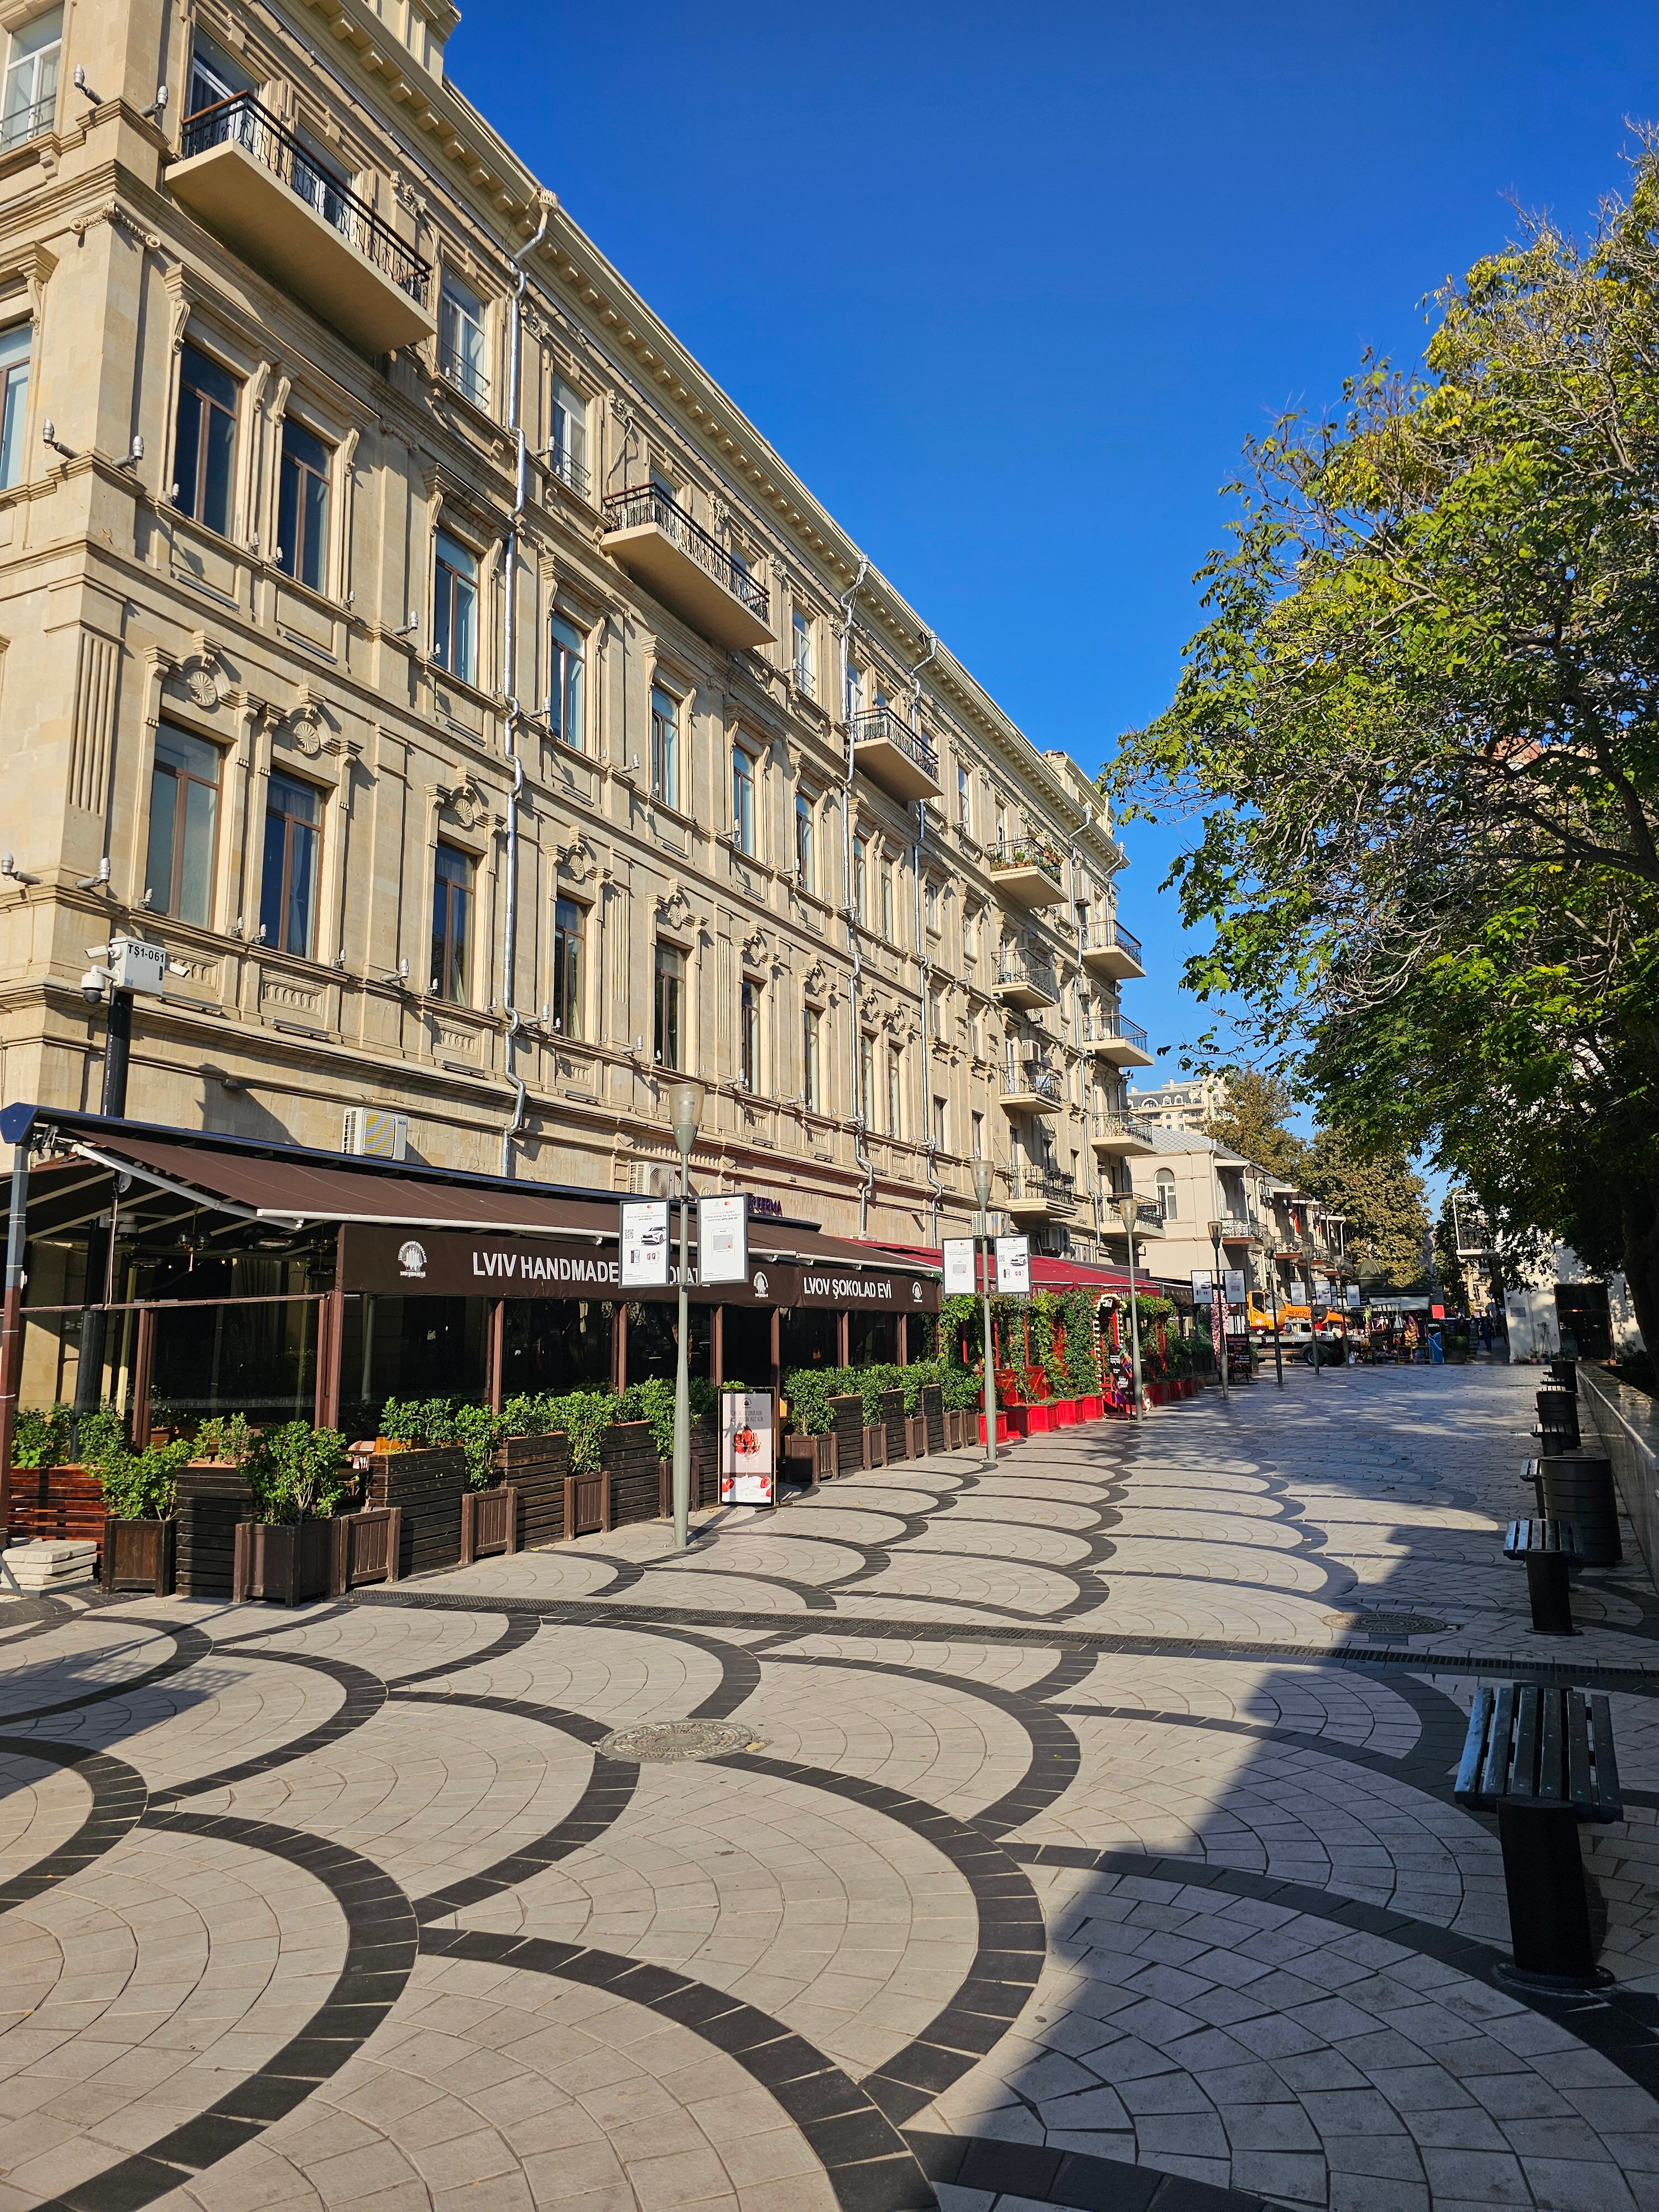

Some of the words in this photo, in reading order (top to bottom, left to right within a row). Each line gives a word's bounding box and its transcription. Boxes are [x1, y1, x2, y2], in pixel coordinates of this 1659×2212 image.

[128, 944, 164, 963] TŞ1-061
[473, 1251, 517, 1277] LVIV
[521, 1256, 619, 1283] HANDMADE
[804, 1277, 830, 1295] LVOV
[832, 1279, 876, 1300] ŞOKOLAD
[878, 1279, 892, 1298] EVİ
